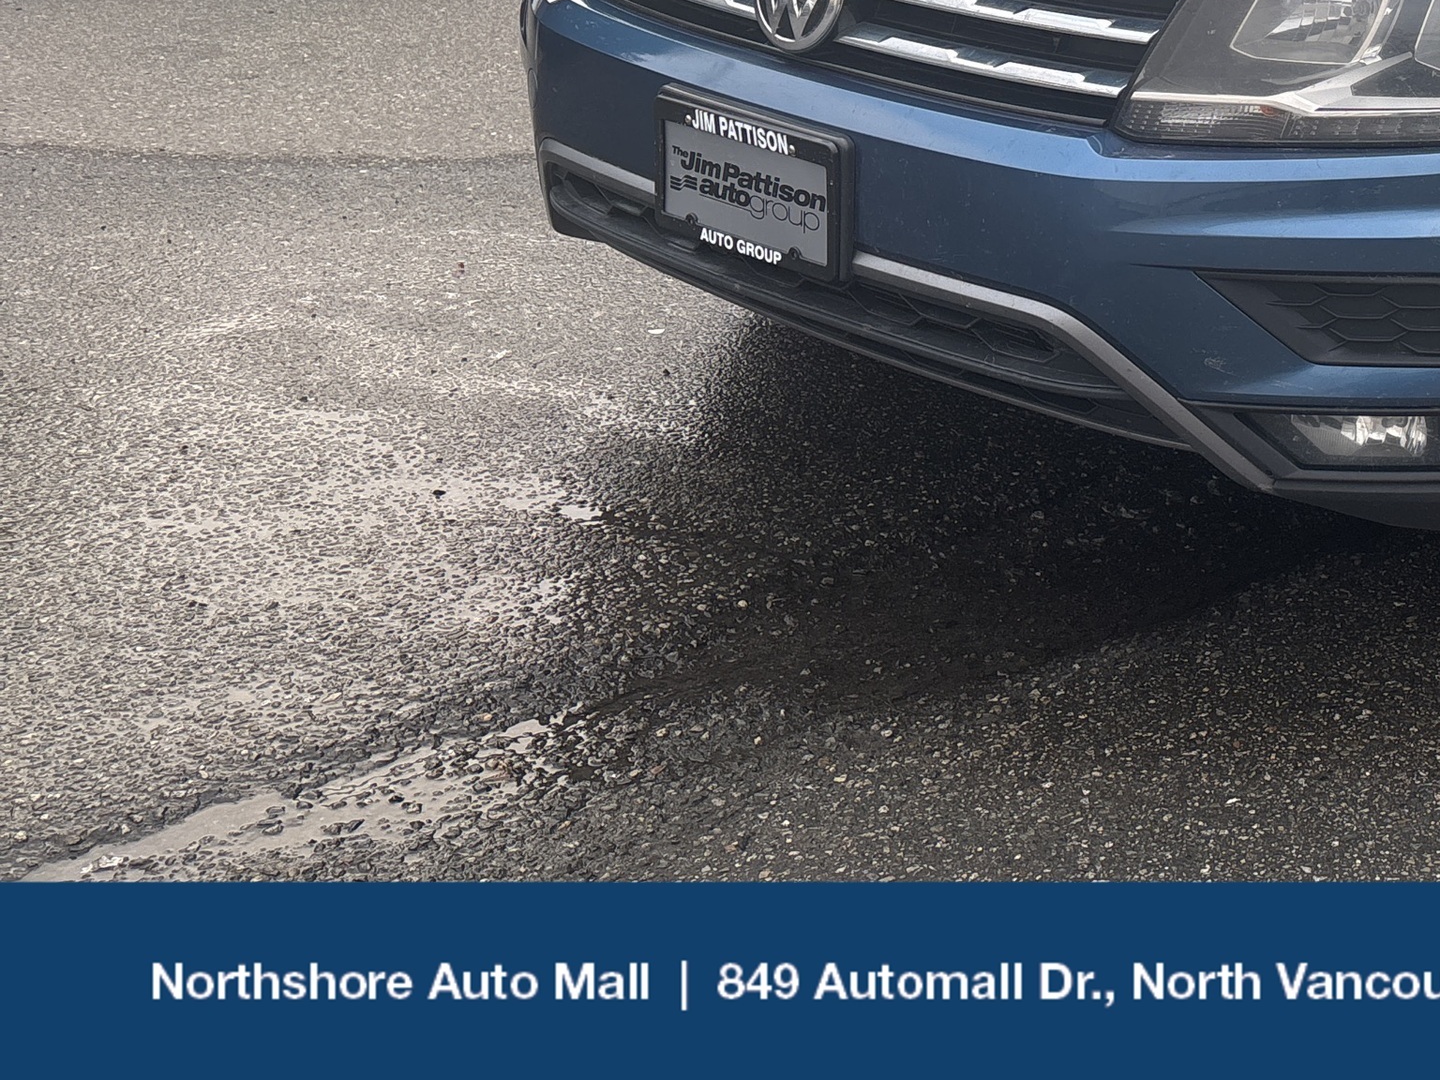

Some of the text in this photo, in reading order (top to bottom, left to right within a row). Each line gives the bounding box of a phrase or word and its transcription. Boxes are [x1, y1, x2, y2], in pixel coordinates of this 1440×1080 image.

[692, 109, 789, 155] JIM PATTISON
[672, 145, 689, 159] The
[700, 227, 782, 265] AUTO GROUP
